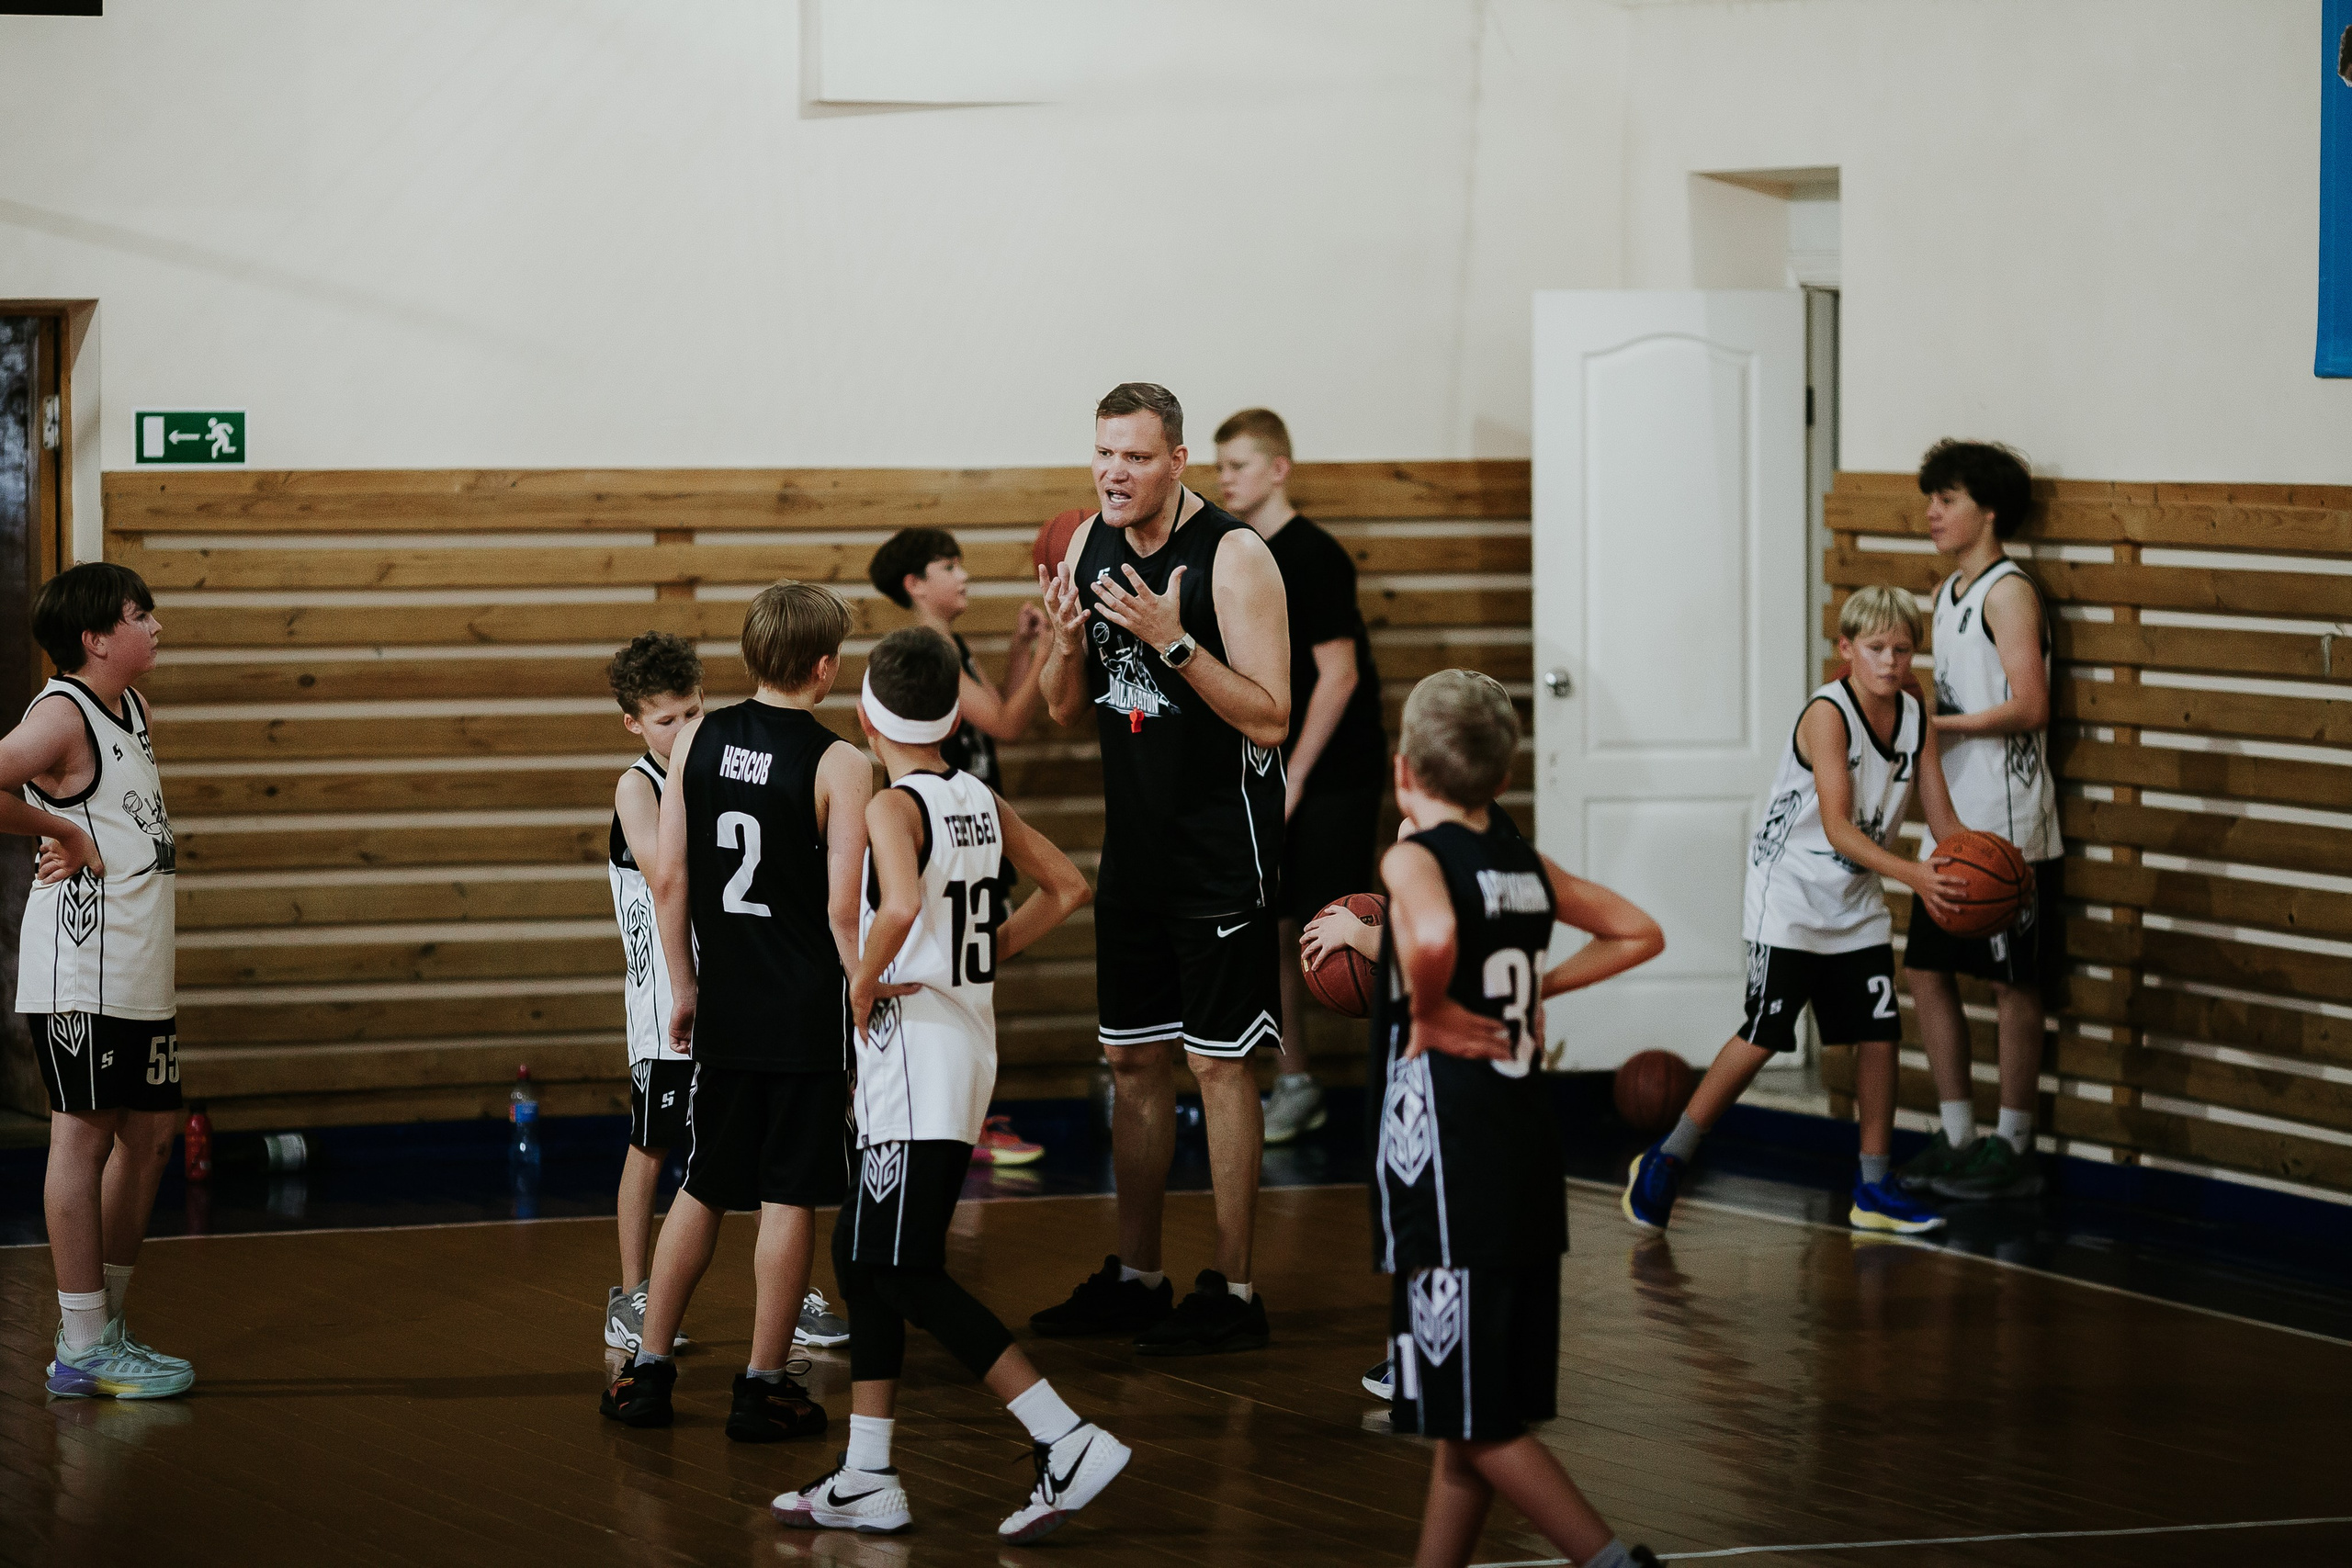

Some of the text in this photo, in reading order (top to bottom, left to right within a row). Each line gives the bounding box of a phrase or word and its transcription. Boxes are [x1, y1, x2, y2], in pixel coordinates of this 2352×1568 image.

[1894, 751, 1911, 783] 2
[717, 811, 772, 917] 2
[943, 877, 996, 987] 13
[1482, 948, 1547, 1079] 3
[1866, 976, 1897, 1021] 2
[145, 1034, 181, 1086] 55
